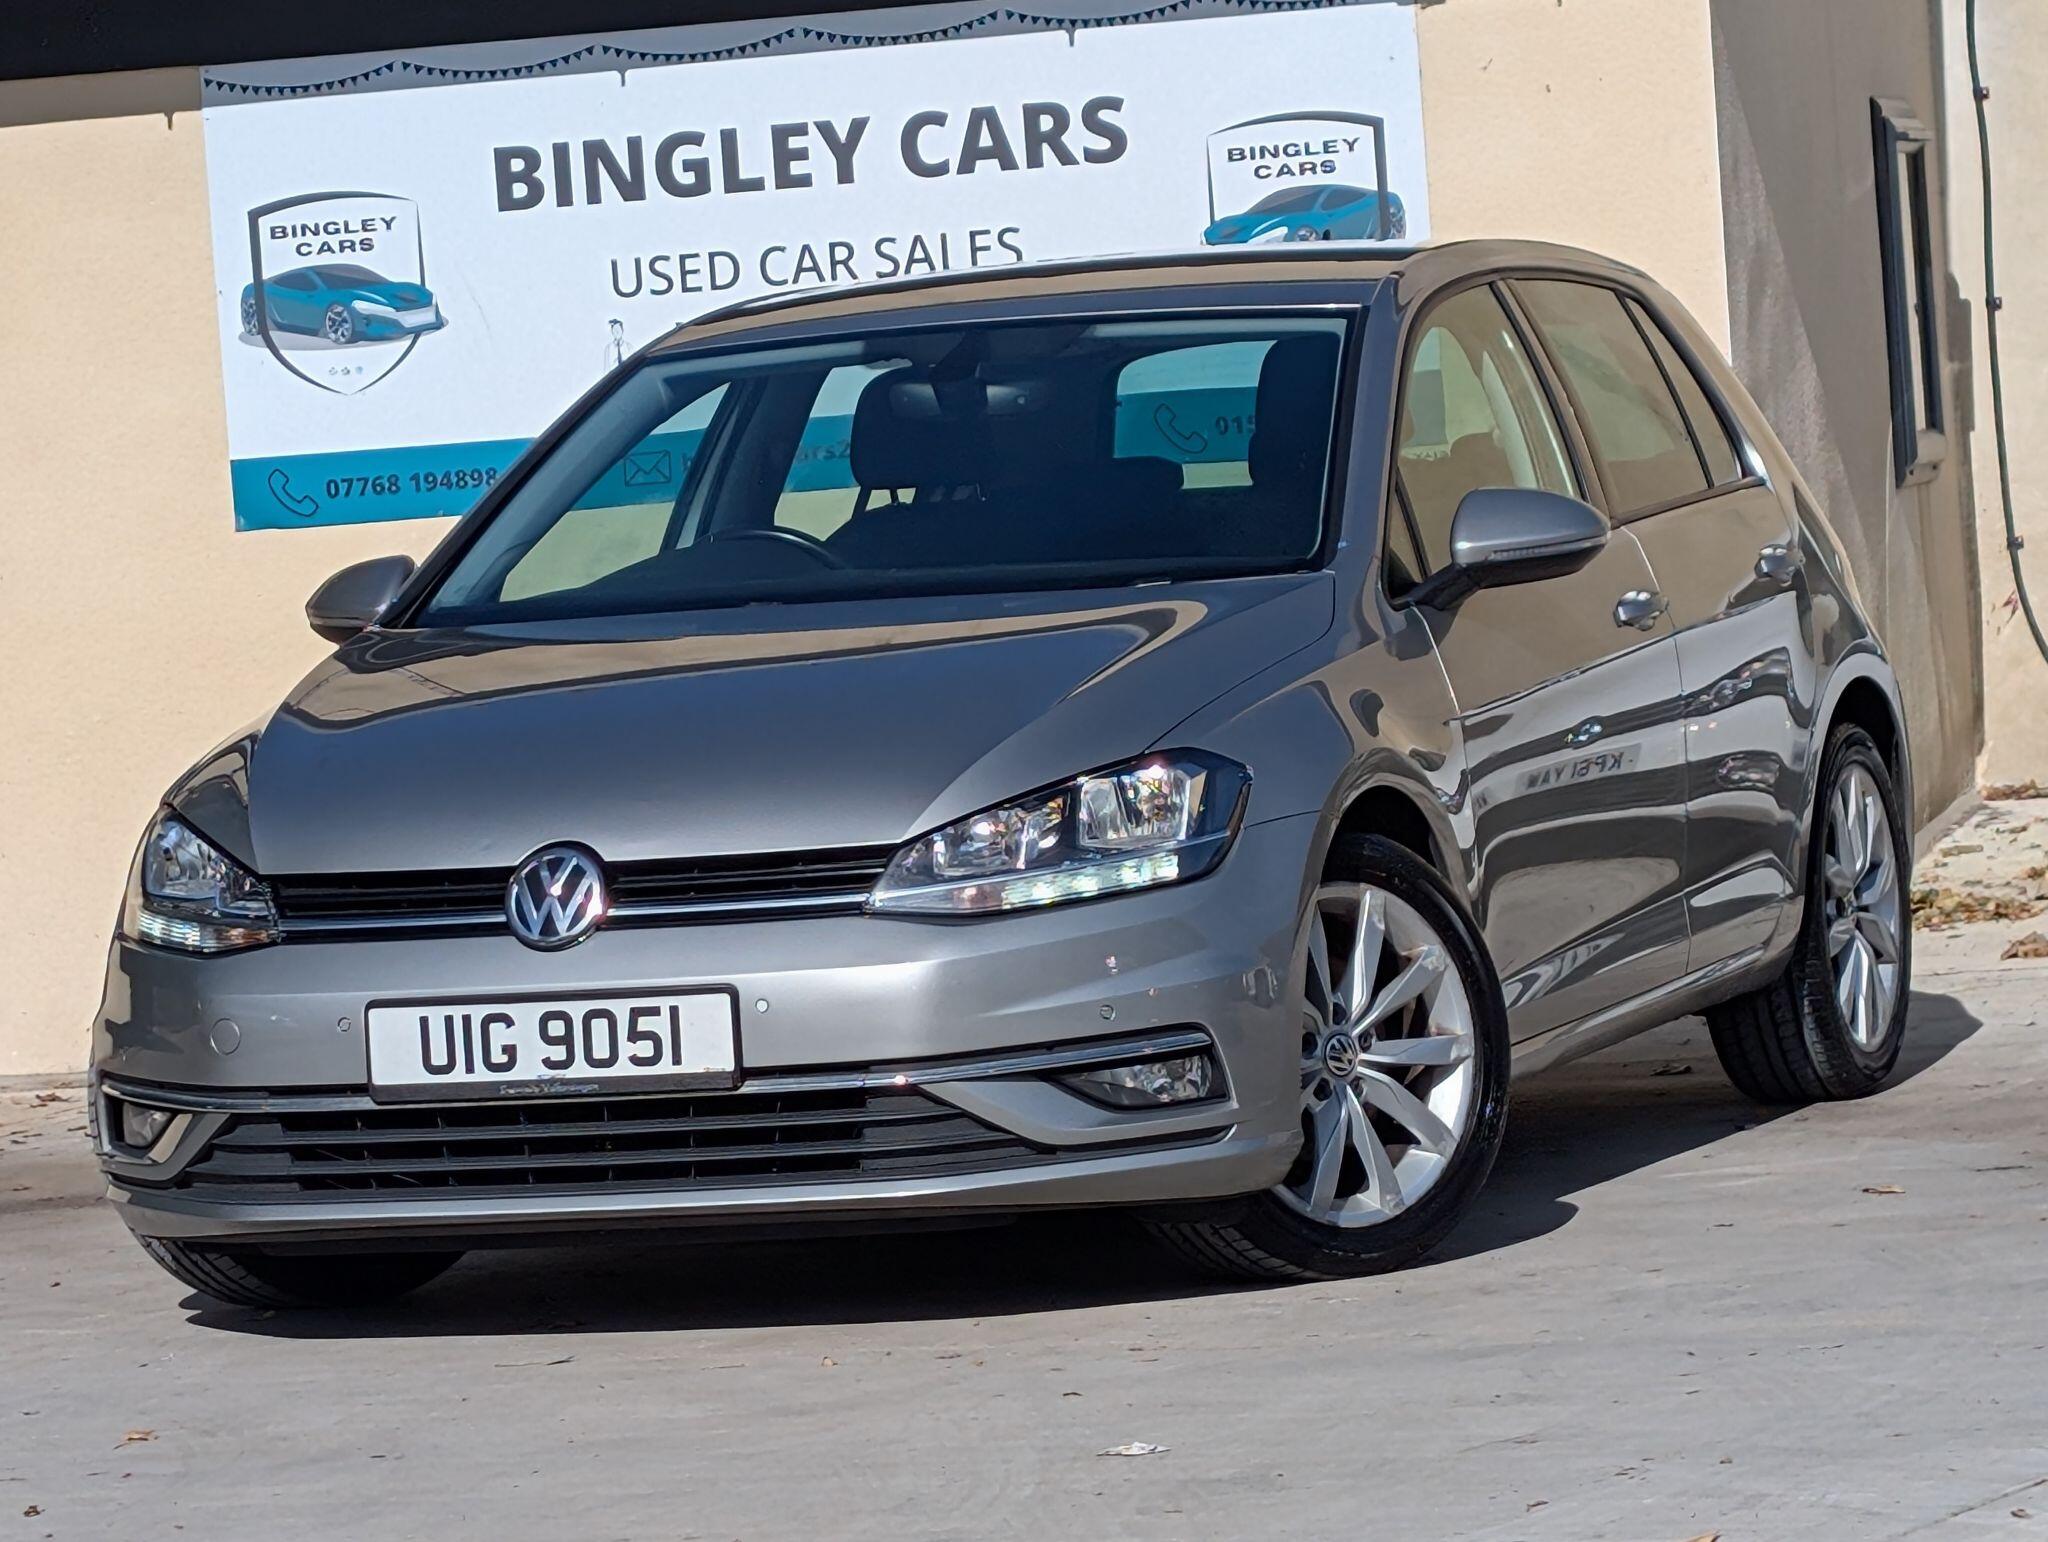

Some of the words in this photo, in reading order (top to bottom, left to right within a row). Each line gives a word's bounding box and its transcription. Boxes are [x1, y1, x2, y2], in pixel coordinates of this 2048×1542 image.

[493, 116, 870, 212] BINGLEY
[900, 96, 1128, 178] CARS
[1227, 137, 1360, 162] BINGLEY
[1254, 160, 1337, 179] CARS
[270, 216, 397, 239] BINGLEY
[295, 238, 375, 256] CARS
[611, 250, 740, 298] USED
[760, 241, 859, 286] CAR
[326, 474, 401, 499] 07768
[409, 467, 497, 492] 194898
[419, 1012, 518, 1075] UIG
[538, 1005, 682, 1070] 9051
